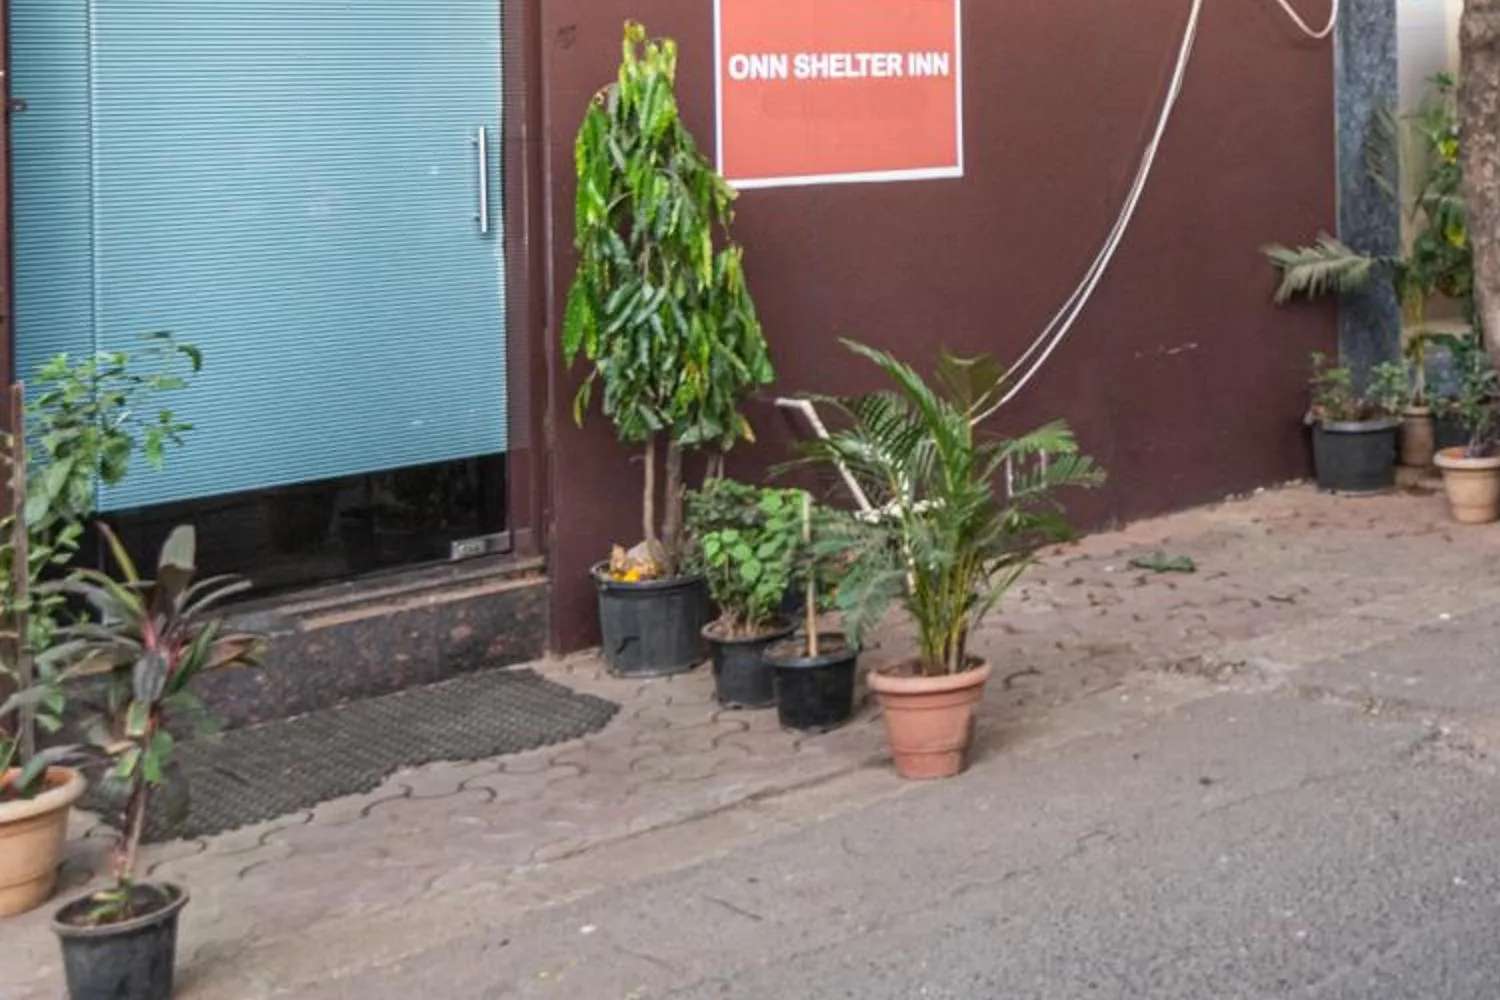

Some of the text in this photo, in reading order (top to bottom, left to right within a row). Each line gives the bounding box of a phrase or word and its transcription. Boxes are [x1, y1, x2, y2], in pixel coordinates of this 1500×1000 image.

[728, 52, 950, 80] ONN SHELTER INN
